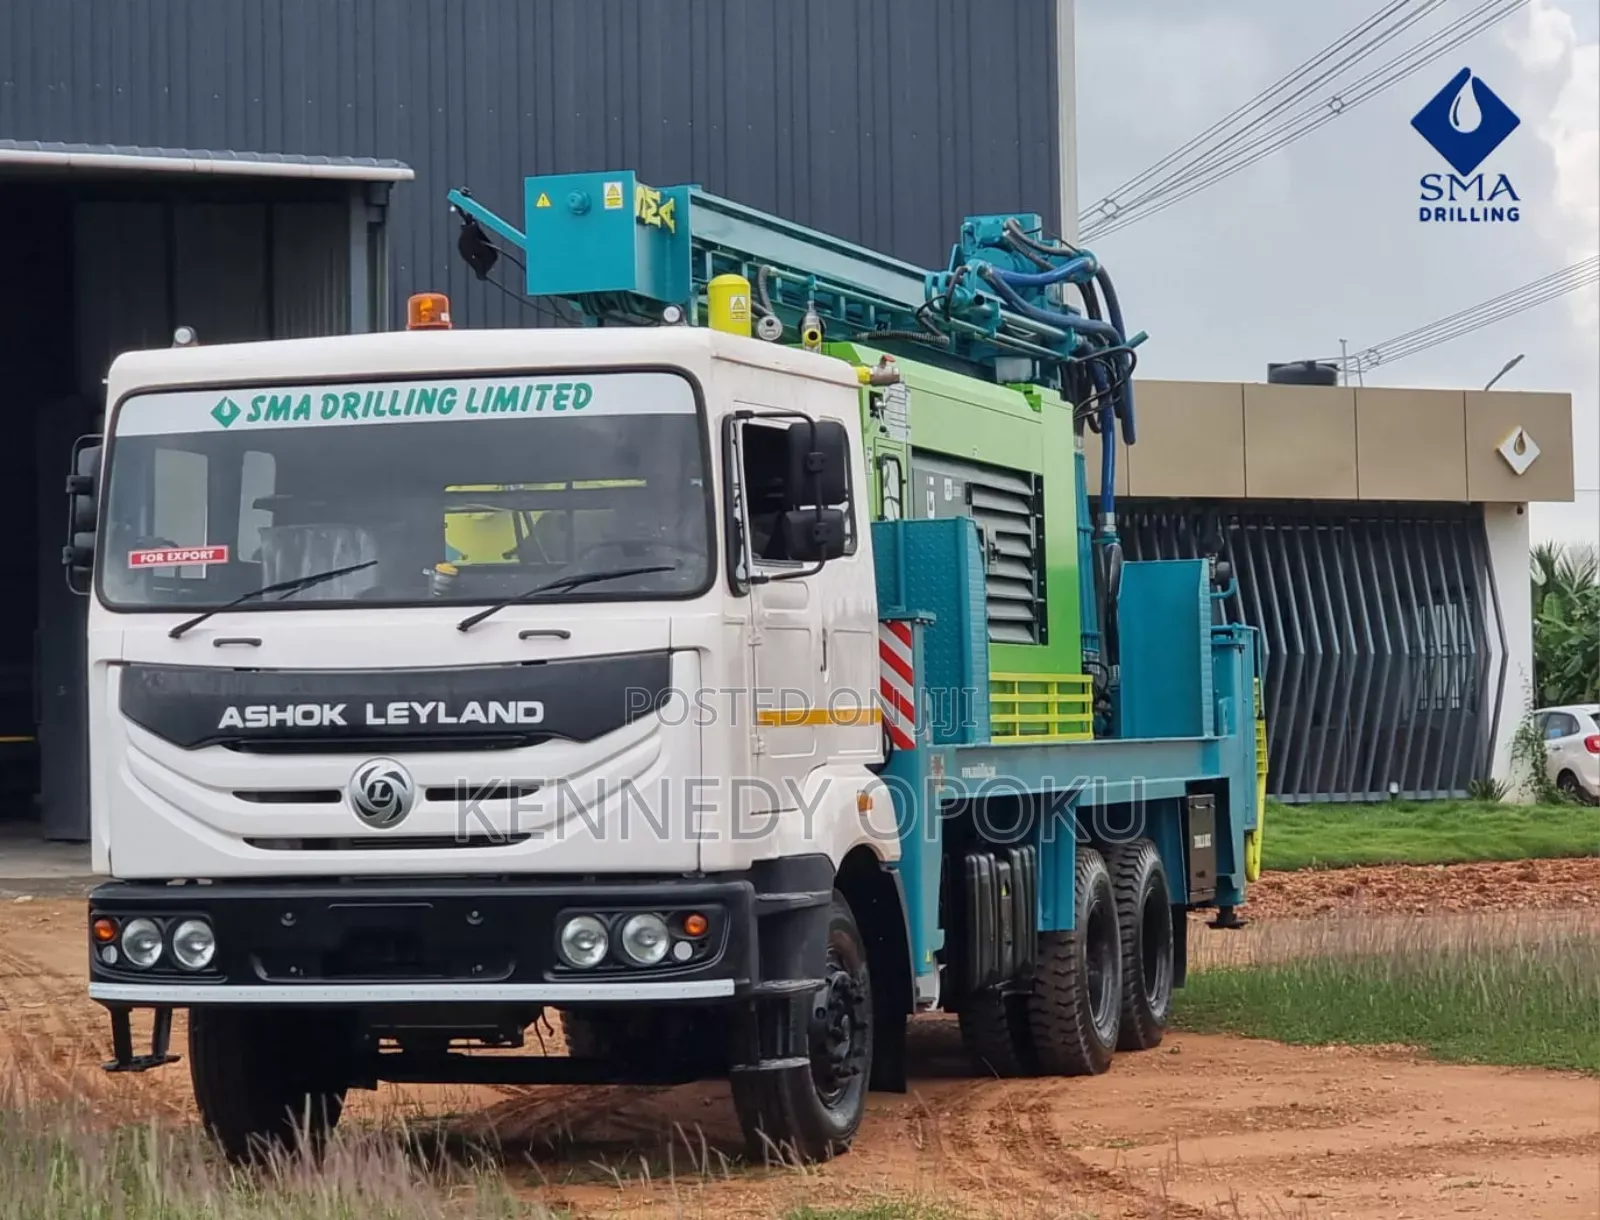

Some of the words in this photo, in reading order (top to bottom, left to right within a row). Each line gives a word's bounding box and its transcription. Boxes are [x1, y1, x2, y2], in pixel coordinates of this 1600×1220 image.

[247, 394, 311, 422] SMA
[320, 387, 457, 420] DRILLING
[465, 382, 592, 413] LIMITED
[140, 552, 164, 563] FOR
[167, 550, 215, 561] EXPORT
[218, 703, 347, 729] ASHOK
[366, 701, 544, 725] LEYLAND
[371, 782, 391, 801] L
